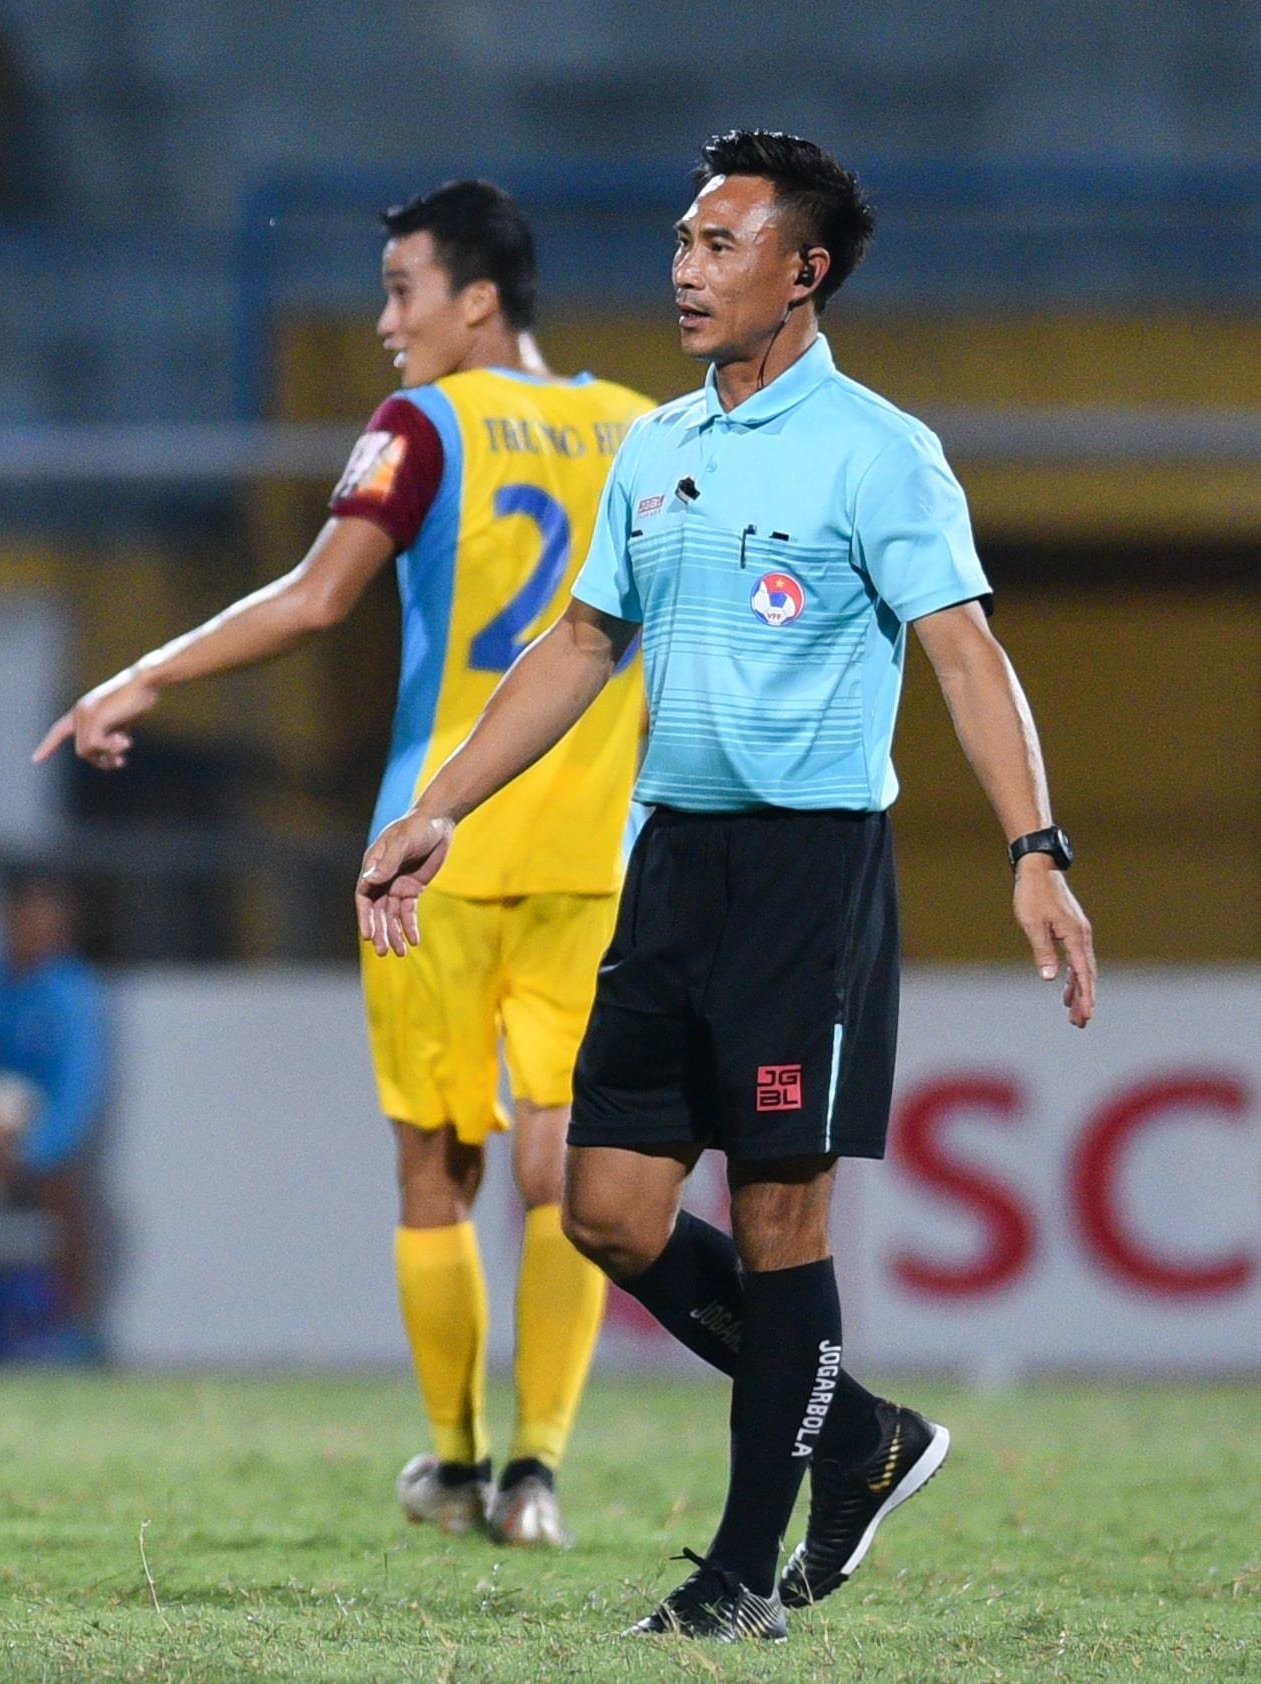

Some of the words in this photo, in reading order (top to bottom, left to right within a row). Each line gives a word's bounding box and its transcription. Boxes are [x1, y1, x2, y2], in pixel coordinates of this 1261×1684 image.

[468, 484, 640, 676] 2
[890, 1067, 1254, 1297] SC
[791, 1340, 841, 1457] JOGARBOLA
